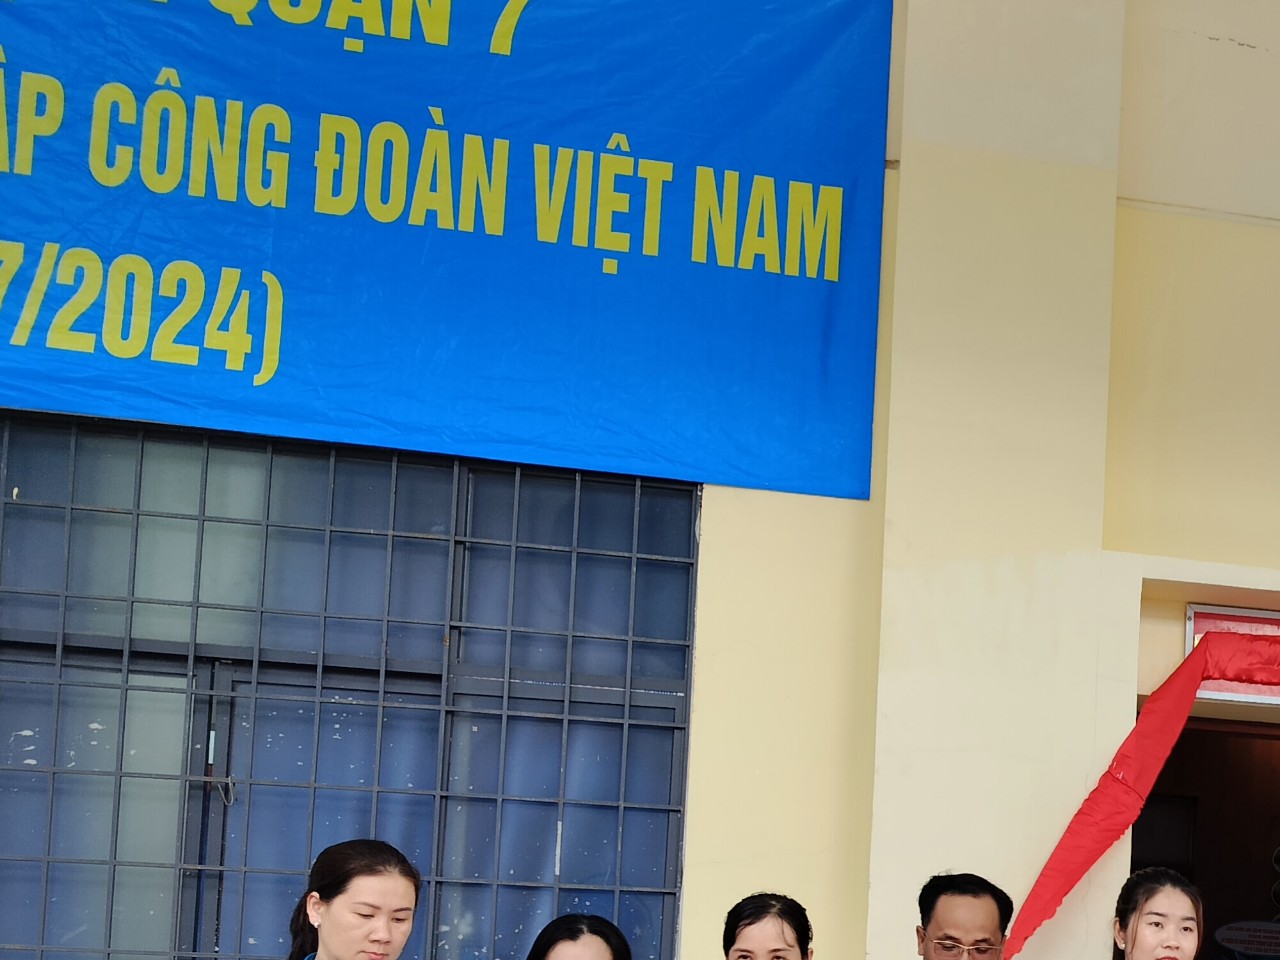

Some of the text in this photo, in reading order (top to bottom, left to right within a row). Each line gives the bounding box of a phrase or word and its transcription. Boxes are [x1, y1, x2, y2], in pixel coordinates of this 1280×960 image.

[88, 67, 291, 208] CÔNG
[314, 106, 509, 236] ĐOÀN
[534, 133, 672, 274] VIỆT
[692, 166, 843, 283] NAM
